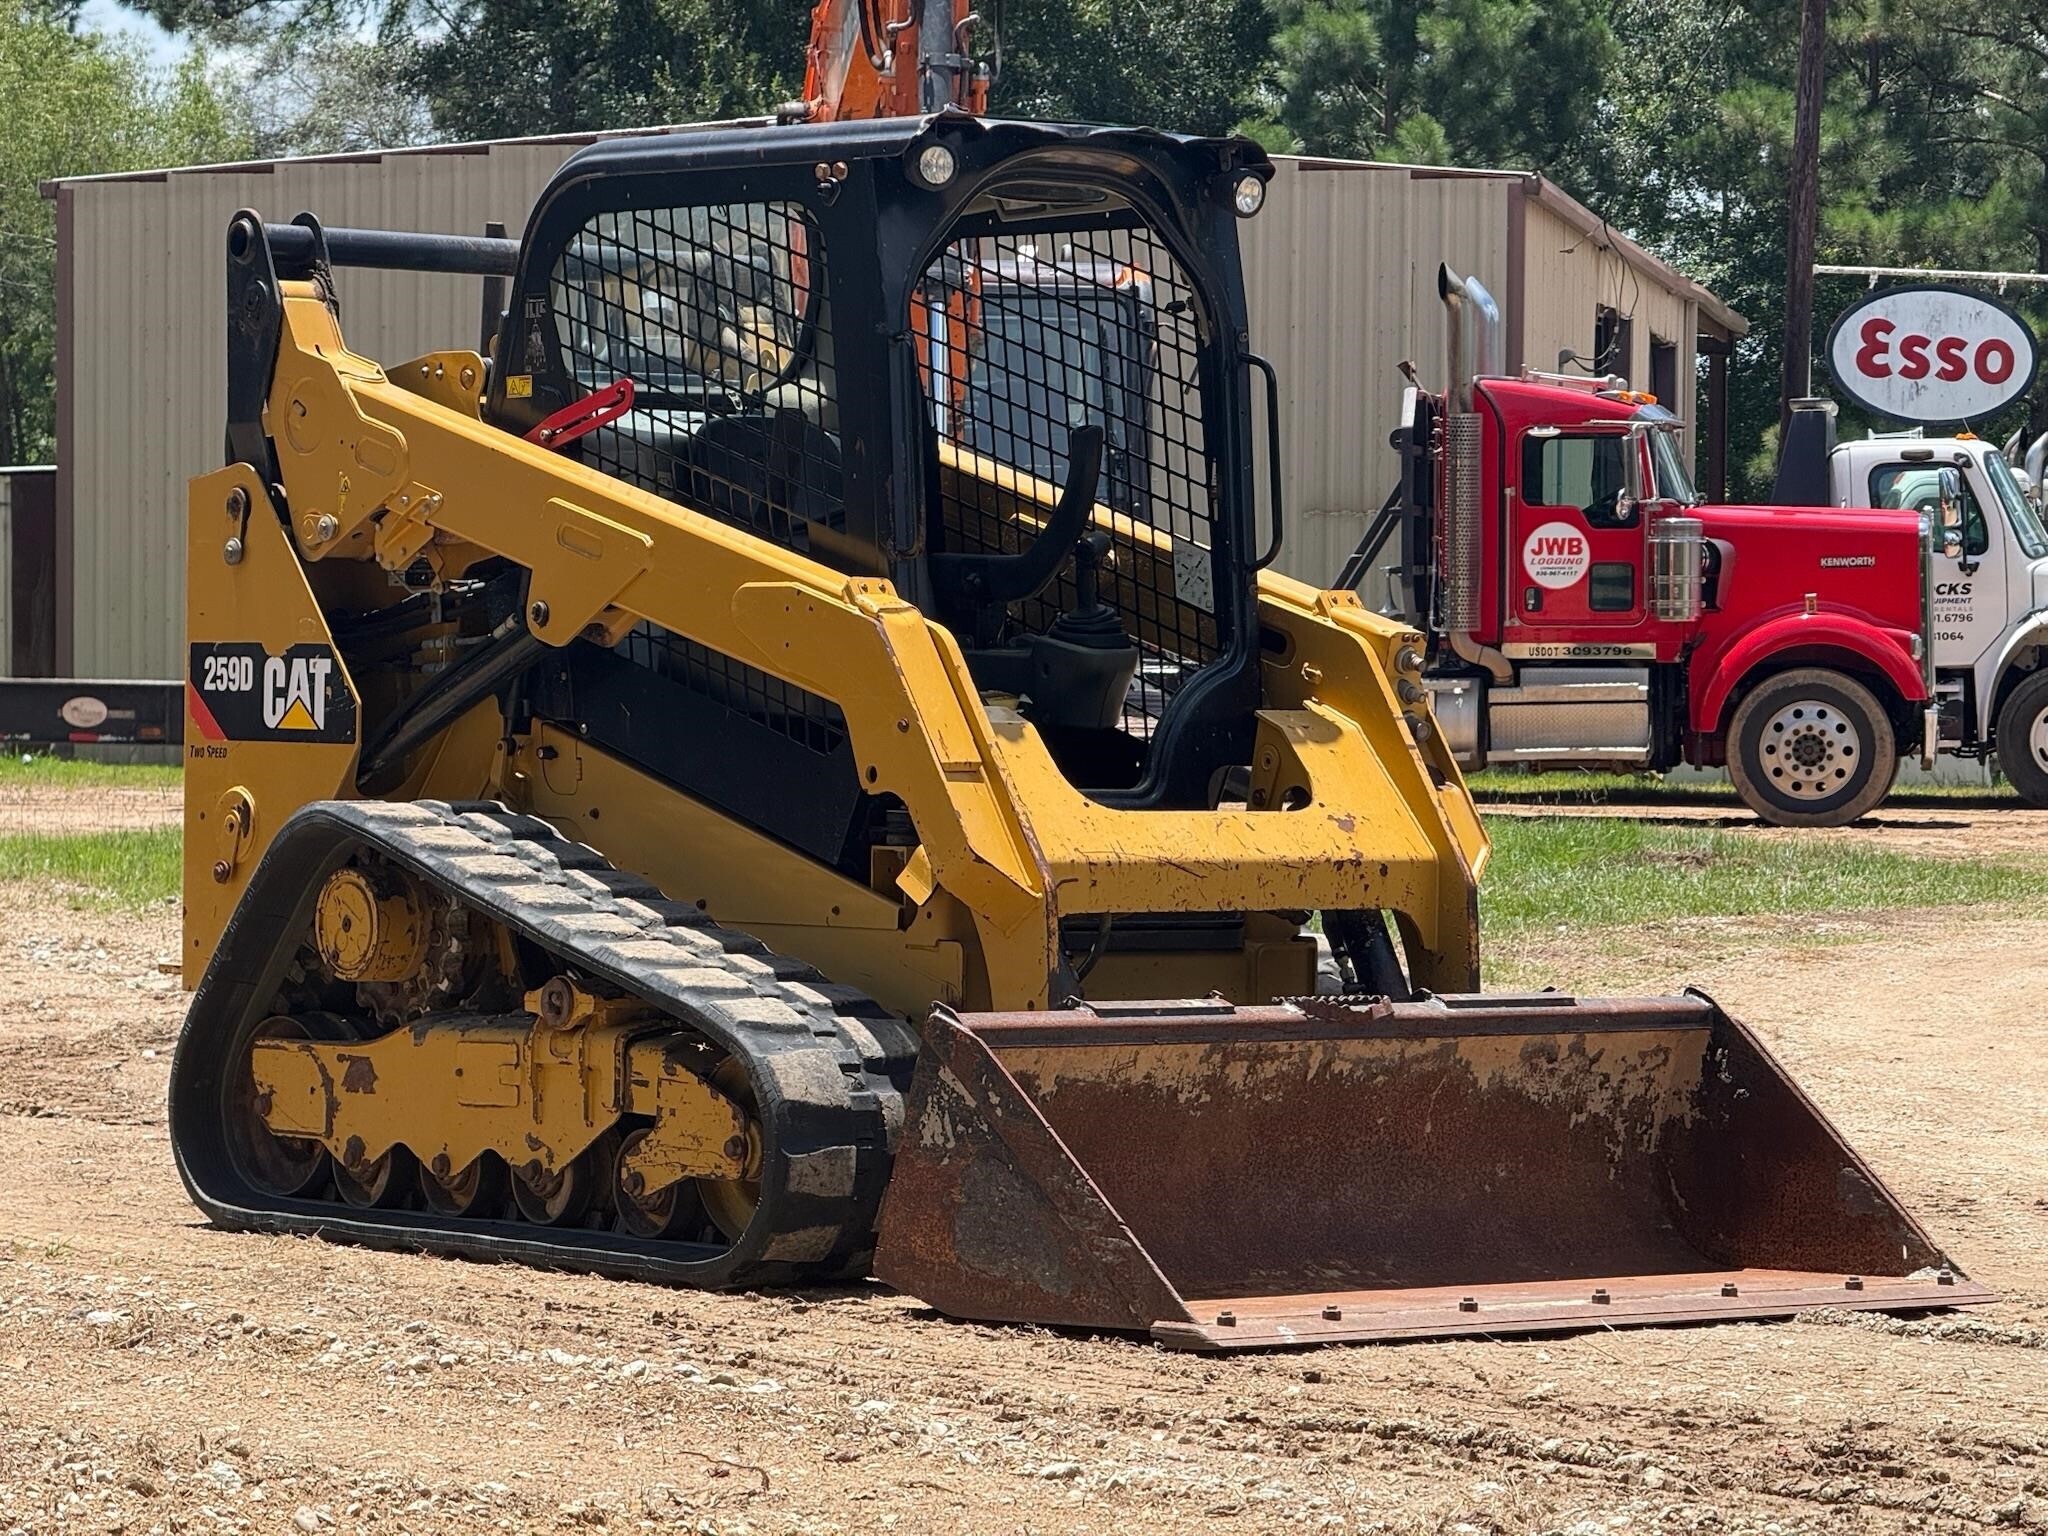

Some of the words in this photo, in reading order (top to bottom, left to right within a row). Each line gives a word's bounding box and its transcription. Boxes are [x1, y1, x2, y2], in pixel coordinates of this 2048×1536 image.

[1856, 318, 2015, 384] Esso
[1530, 537, 1583, 556] JWB
[1530, 558, 1584, 566] LOGGING
[1820, 556, 1876, 567] KENWORTH
[1934, 583, 1972, 596] CKS
[1934, 613, 1974, 623] 1.6796
[1528, 646, 1559, 657] USDOT
[203, 656, 254, 692] 259D
[263, 656, 332, 731] CAT
